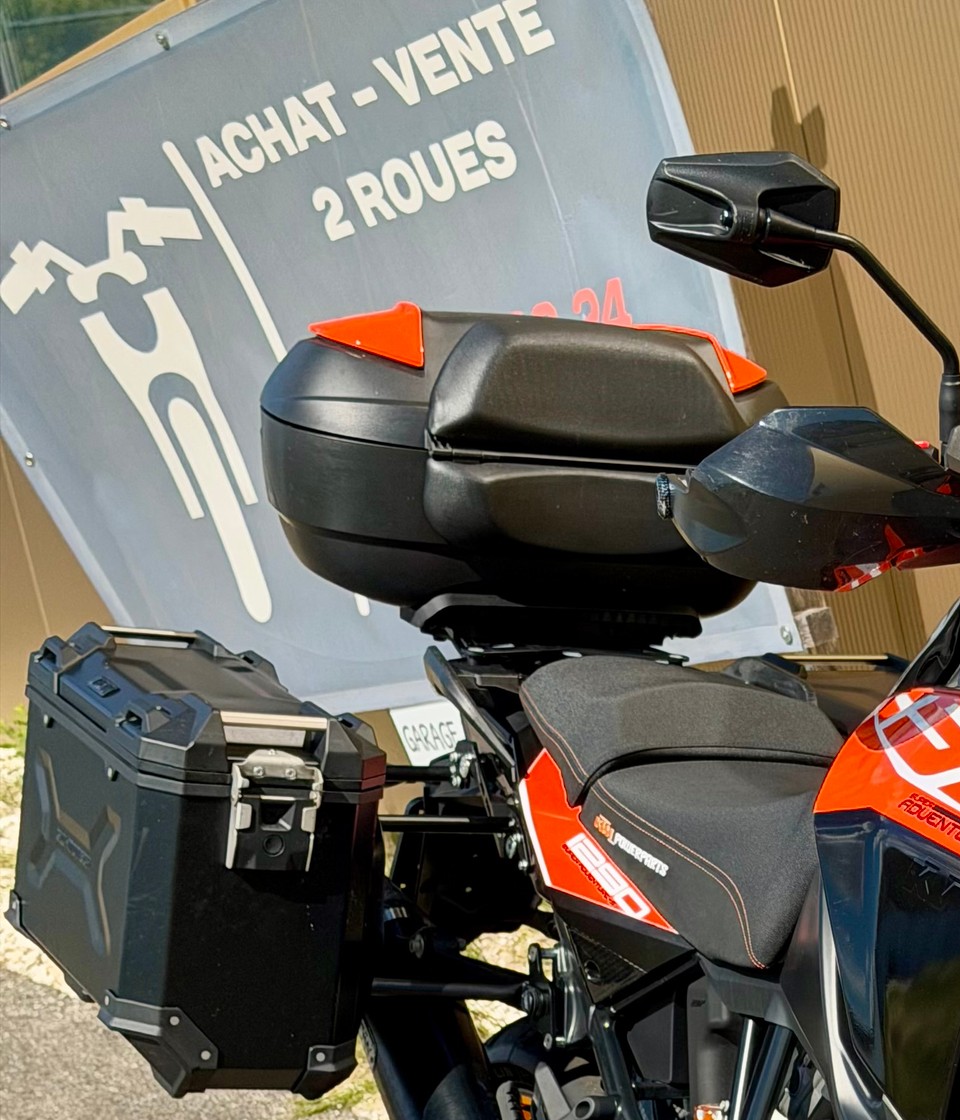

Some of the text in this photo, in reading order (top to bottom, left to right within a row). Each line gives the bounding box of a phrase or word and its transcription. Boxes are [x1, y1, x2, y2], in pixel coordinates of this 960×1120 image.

[196, 81, 347, 188] ACHAT
[372, 0, 555, 106] VENTE
[312, 120, 518, 241] 2 ROUES
[565, 832, 651, 919] 1290
